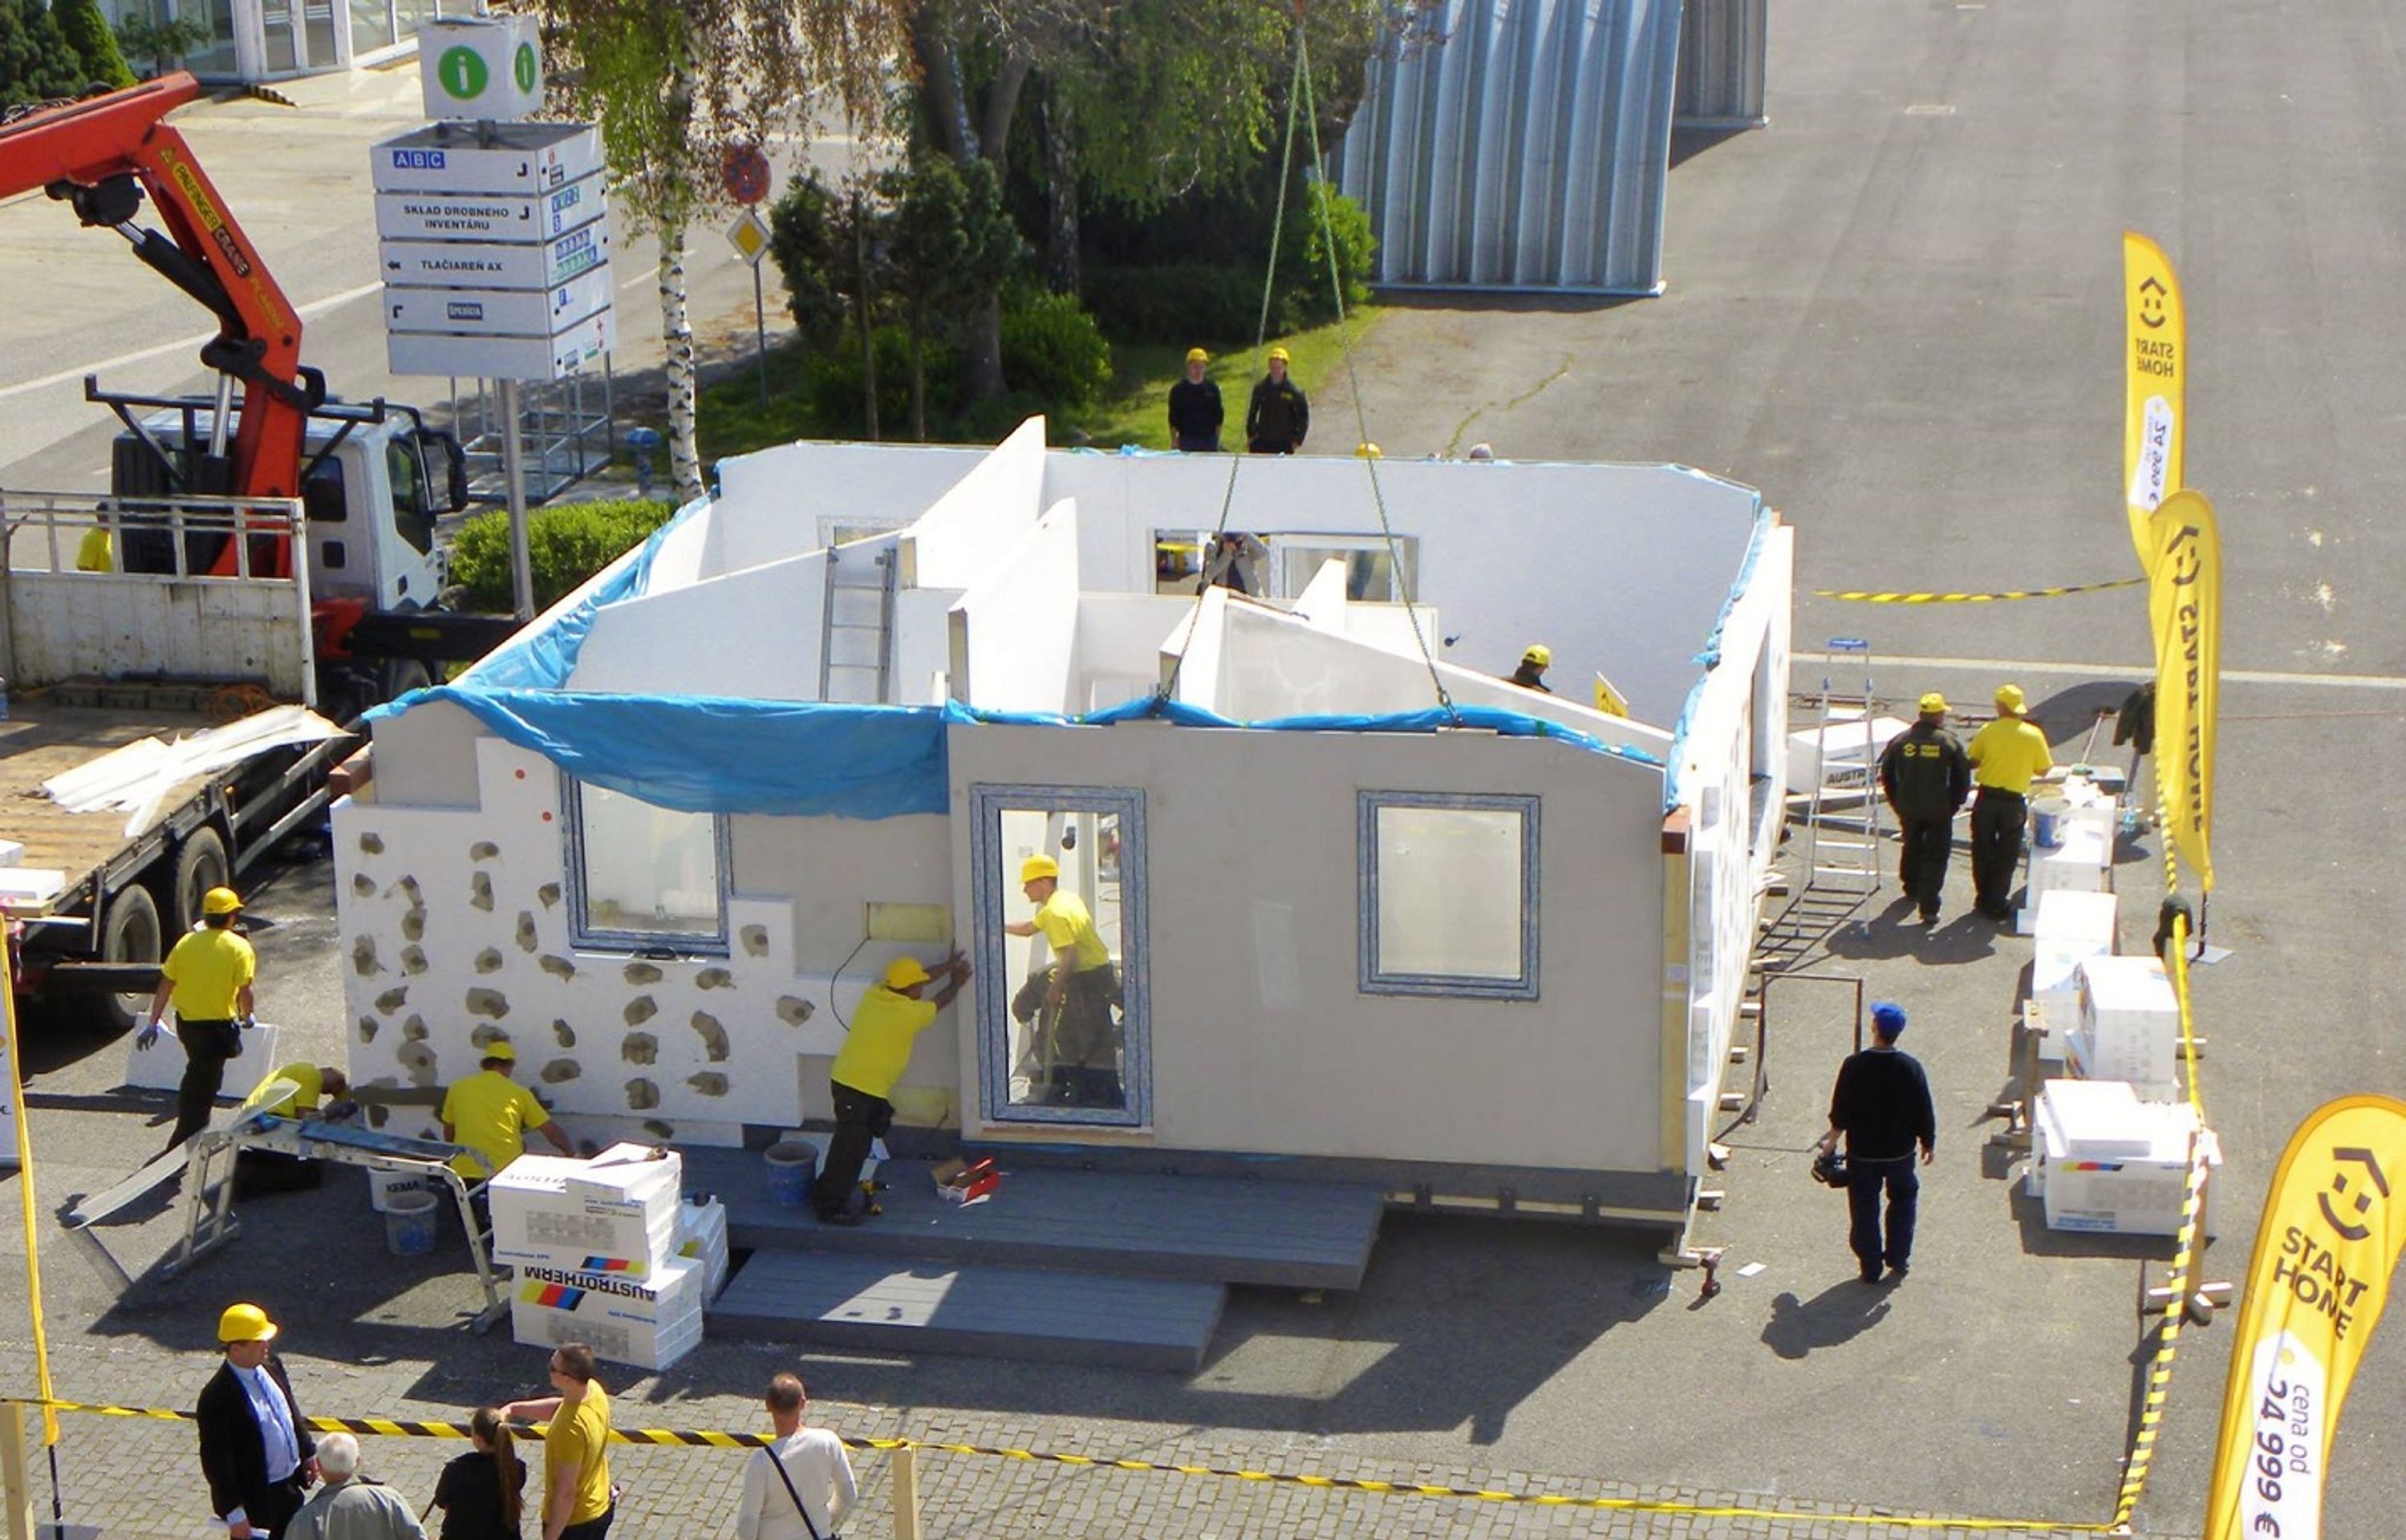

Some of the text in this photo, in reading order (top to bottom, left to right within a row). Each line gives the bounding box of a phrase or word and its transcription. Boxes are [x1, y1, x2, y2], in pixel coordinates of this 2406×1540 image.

[177, 164, 250, 274] PALFINGER CRANE
[404, 205, 509, 217] SKLAD DROBNÉHO
[424, 219, 489, 229] INVENTÁRU
[421, 258, 503, 271] TLAČIAREŇ AX
[525, 1266, 657, 1302] AUSTROTHERM
[2289, 1384, 2311, 1475] cena od
[2257, 1431, 2285, 1502] 999
[2254, 1512, 2280, 1539] €
